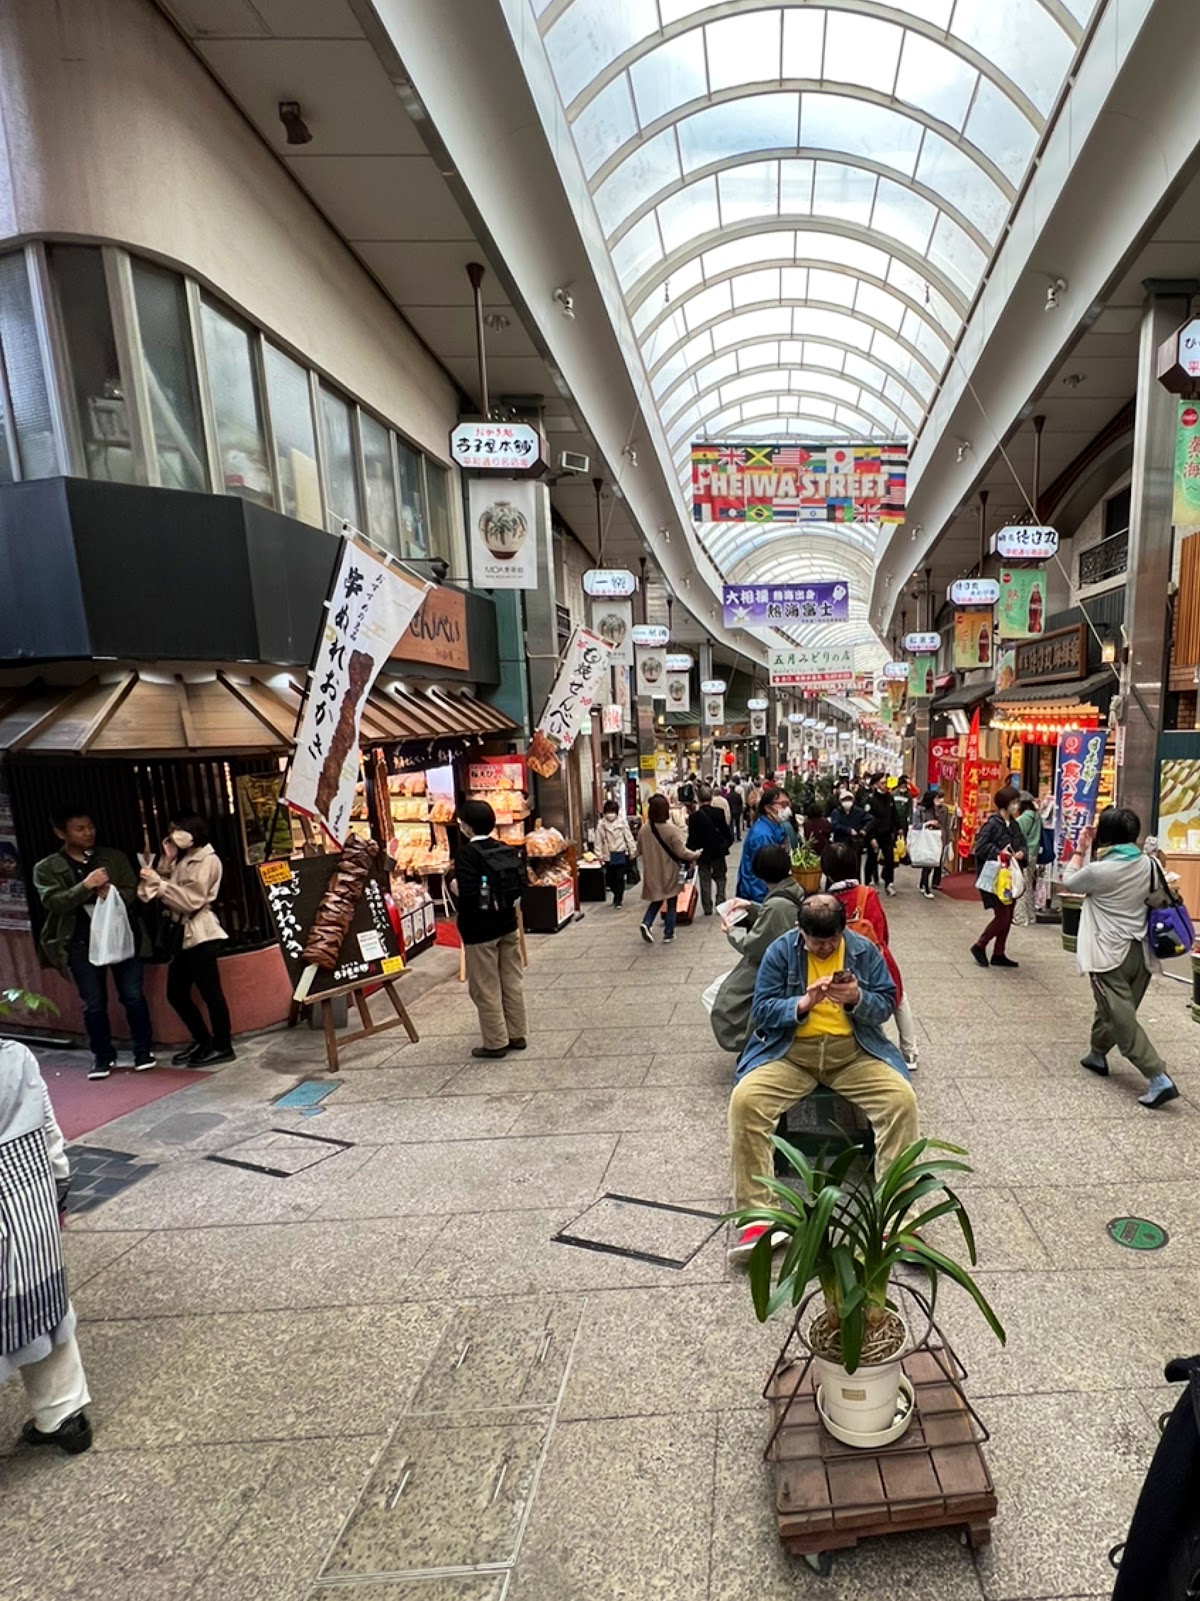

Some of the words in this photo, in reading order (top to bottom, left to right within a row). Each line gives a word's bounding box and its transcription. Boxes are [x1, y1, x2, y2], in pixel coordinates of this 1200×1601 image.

[1185, 337, 1200, 349] ひ
[710, 471, 796, 498] HEIWA
[800, 471, 890, 498] STREET
[773, 650, 851, 665] 五月みどりの店
